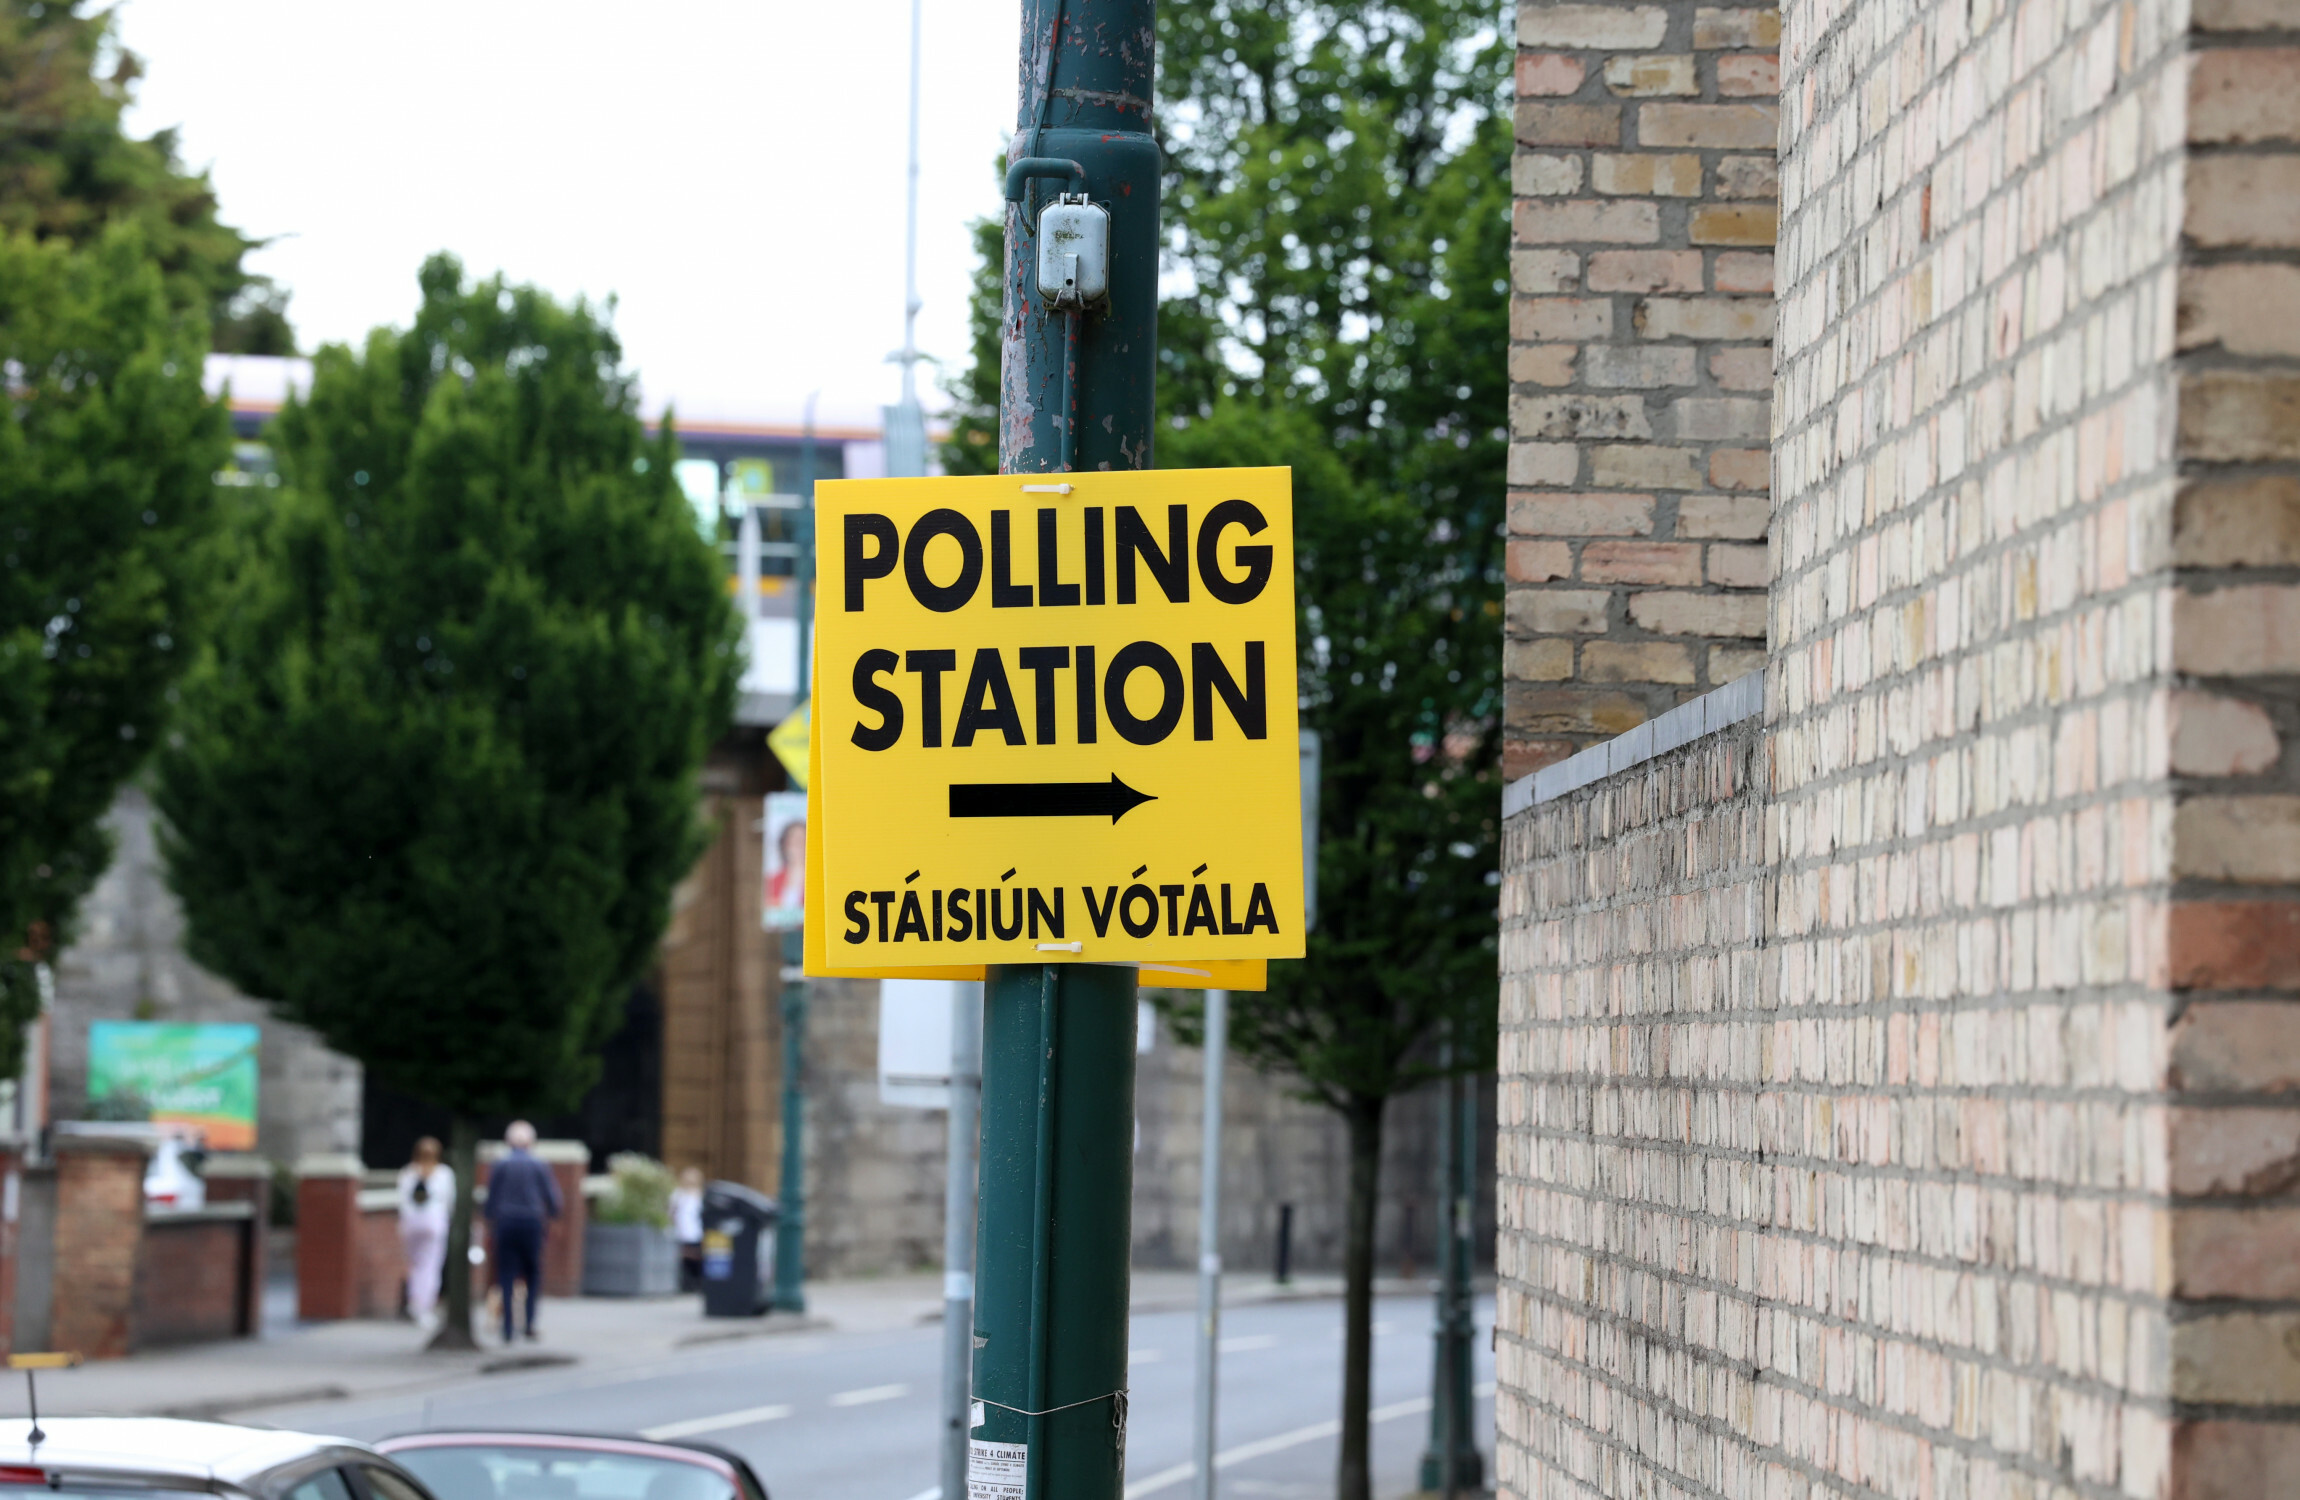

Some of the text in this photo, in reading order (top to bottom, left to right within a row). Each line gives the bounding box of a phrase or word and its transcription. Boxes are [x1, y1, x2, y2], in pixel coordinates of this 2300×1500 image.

[844, 499, 1273, 612] POLLING
[851, 641, 1267, 751] STATION
[844, 863, 1280, 944] STÁISIÚN VÓTÁLA
[997, 1450, 1026, 1460] CLIMATE
